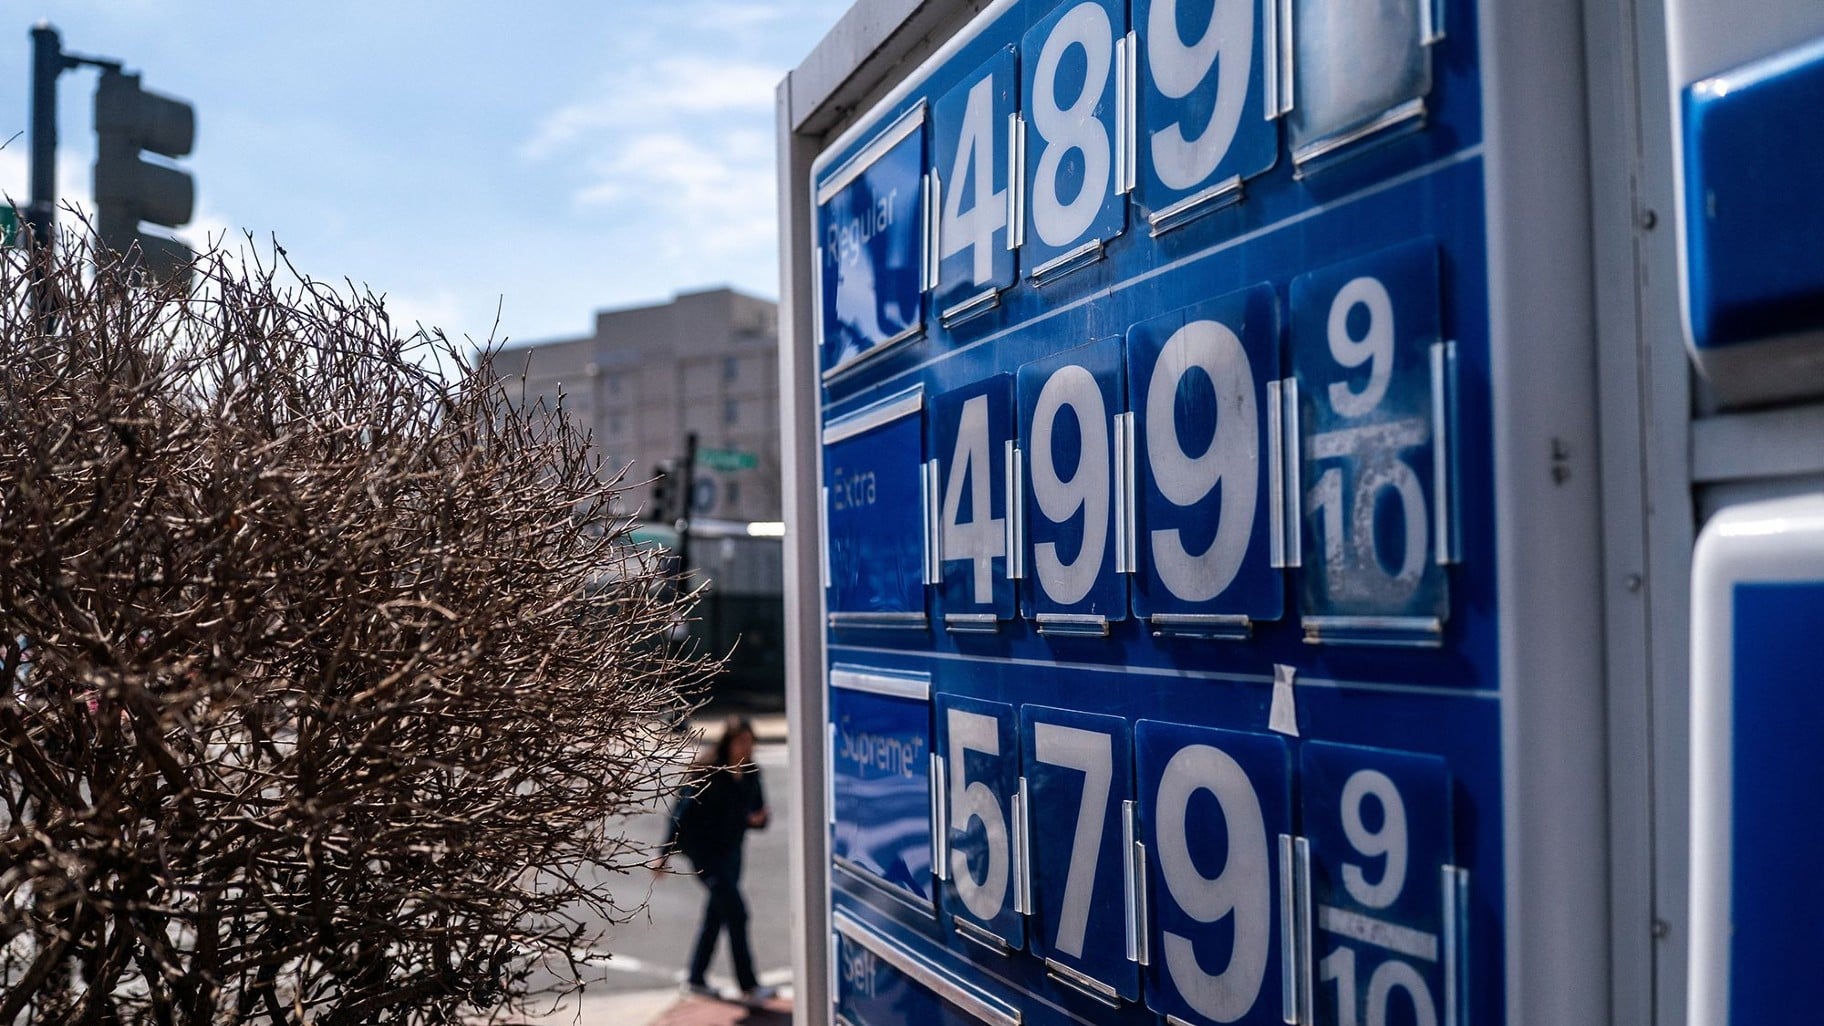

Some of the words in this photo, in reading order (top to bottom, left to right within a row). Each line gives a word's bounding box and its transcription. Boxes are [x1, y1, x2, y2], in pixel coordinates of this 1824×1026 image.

[828, 187, 897, 267] Regular
[834, 467, 876, 510] Extra
[842, 937, 876, 998] Self
